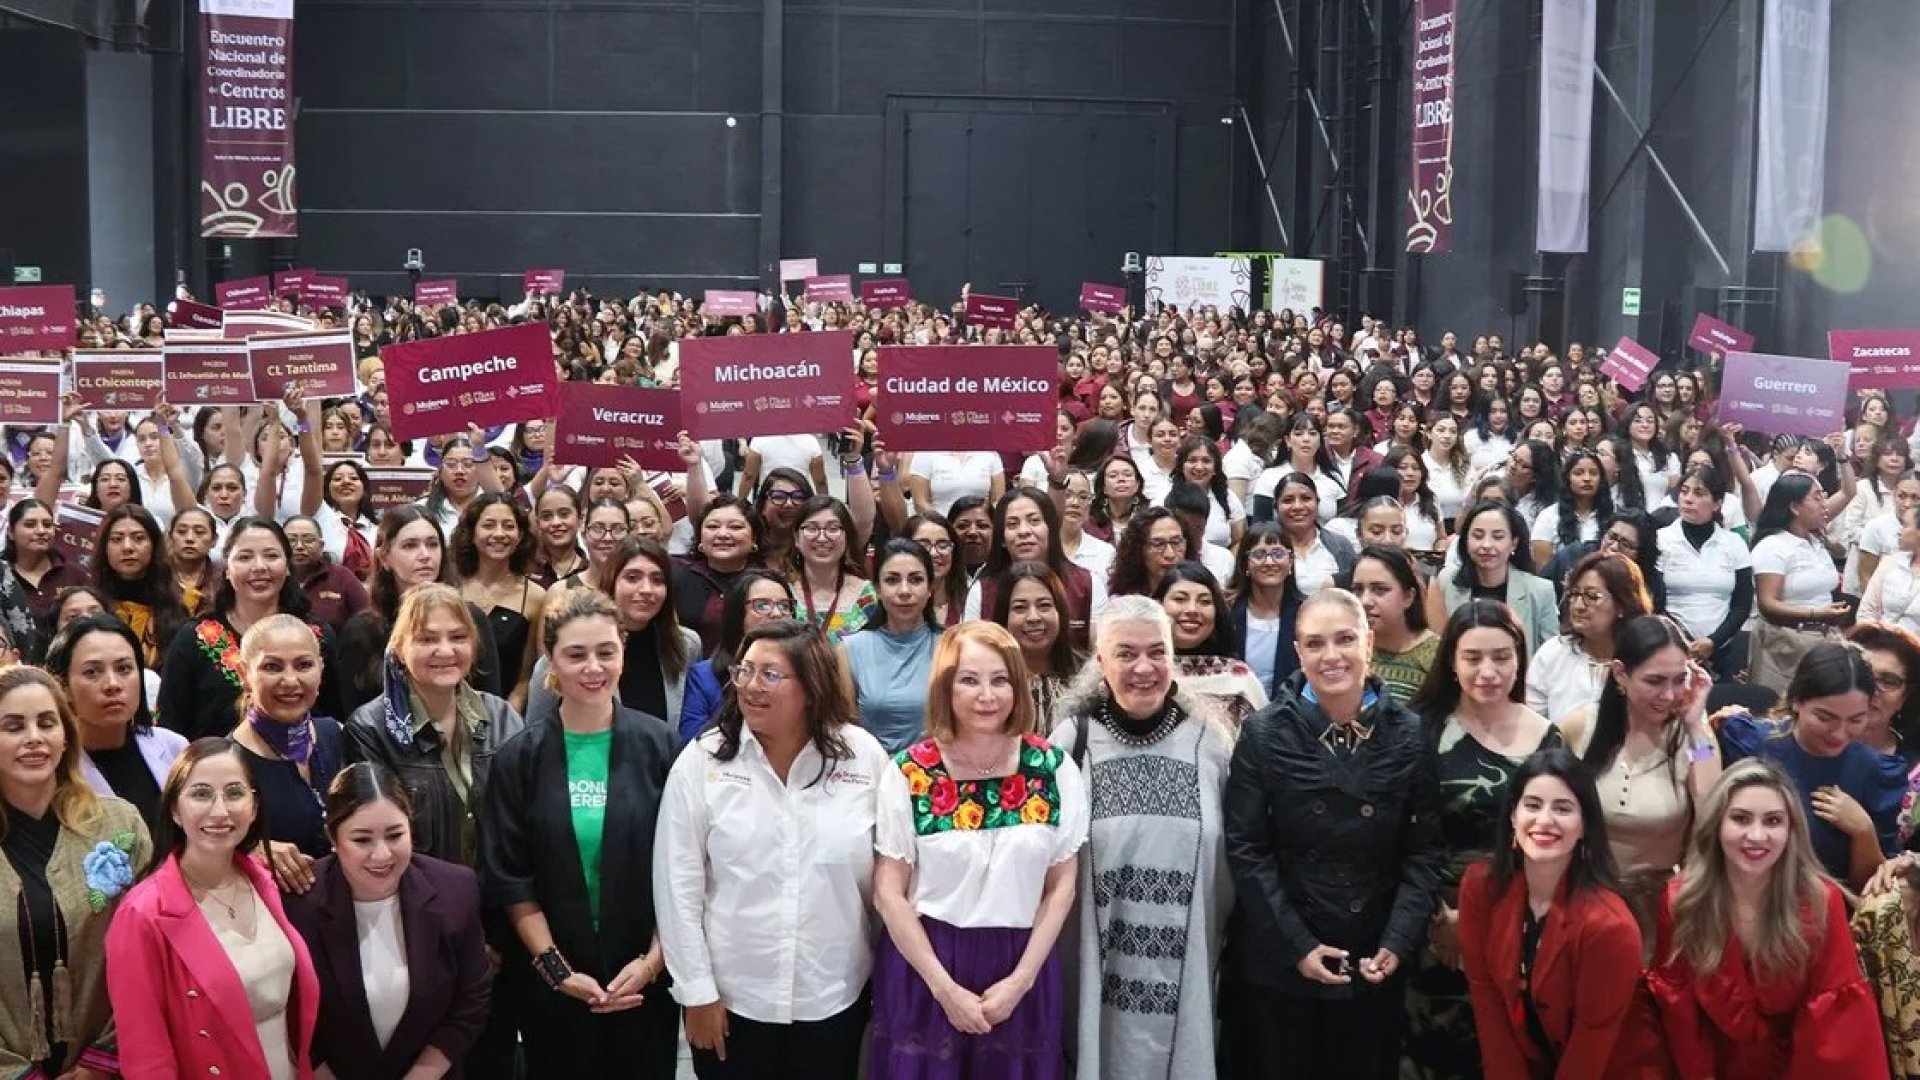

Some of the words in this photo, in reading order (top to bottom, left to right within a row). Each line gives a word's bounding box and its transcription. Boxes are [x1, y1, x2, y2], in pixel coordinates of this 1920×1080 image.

[210, 29, 286, 47] Encuentro
[208, 48, 267, 64] Nacional
[269, 52, 286, 65] de
[220, 81, 285, 99] Centros
[209, 105, 286, 130] LIBRE
[1416, 98, 1452, 128] LIBRE
[1853, 346, 1911, 357] Zacatecas
[267, 365, 283, 376] CL
[286, 361, 337, 375] Tantima
[417, 355, 517, 383] Campeche
[715, 360, 821, 383] Michoacán
[78, 377, 93, 387] CL
[95, 377, 161, 389] Chicontepe
[886, 376, 950, 393] Ciudad
[955, 377, 978, 393] de
[983, 376, 1049, 393] México
[1753, 376, 1817, 394] Guerrero
[592, 407, 665, 426] Veracruz
[905, 412, 940, 422] Mujeres
